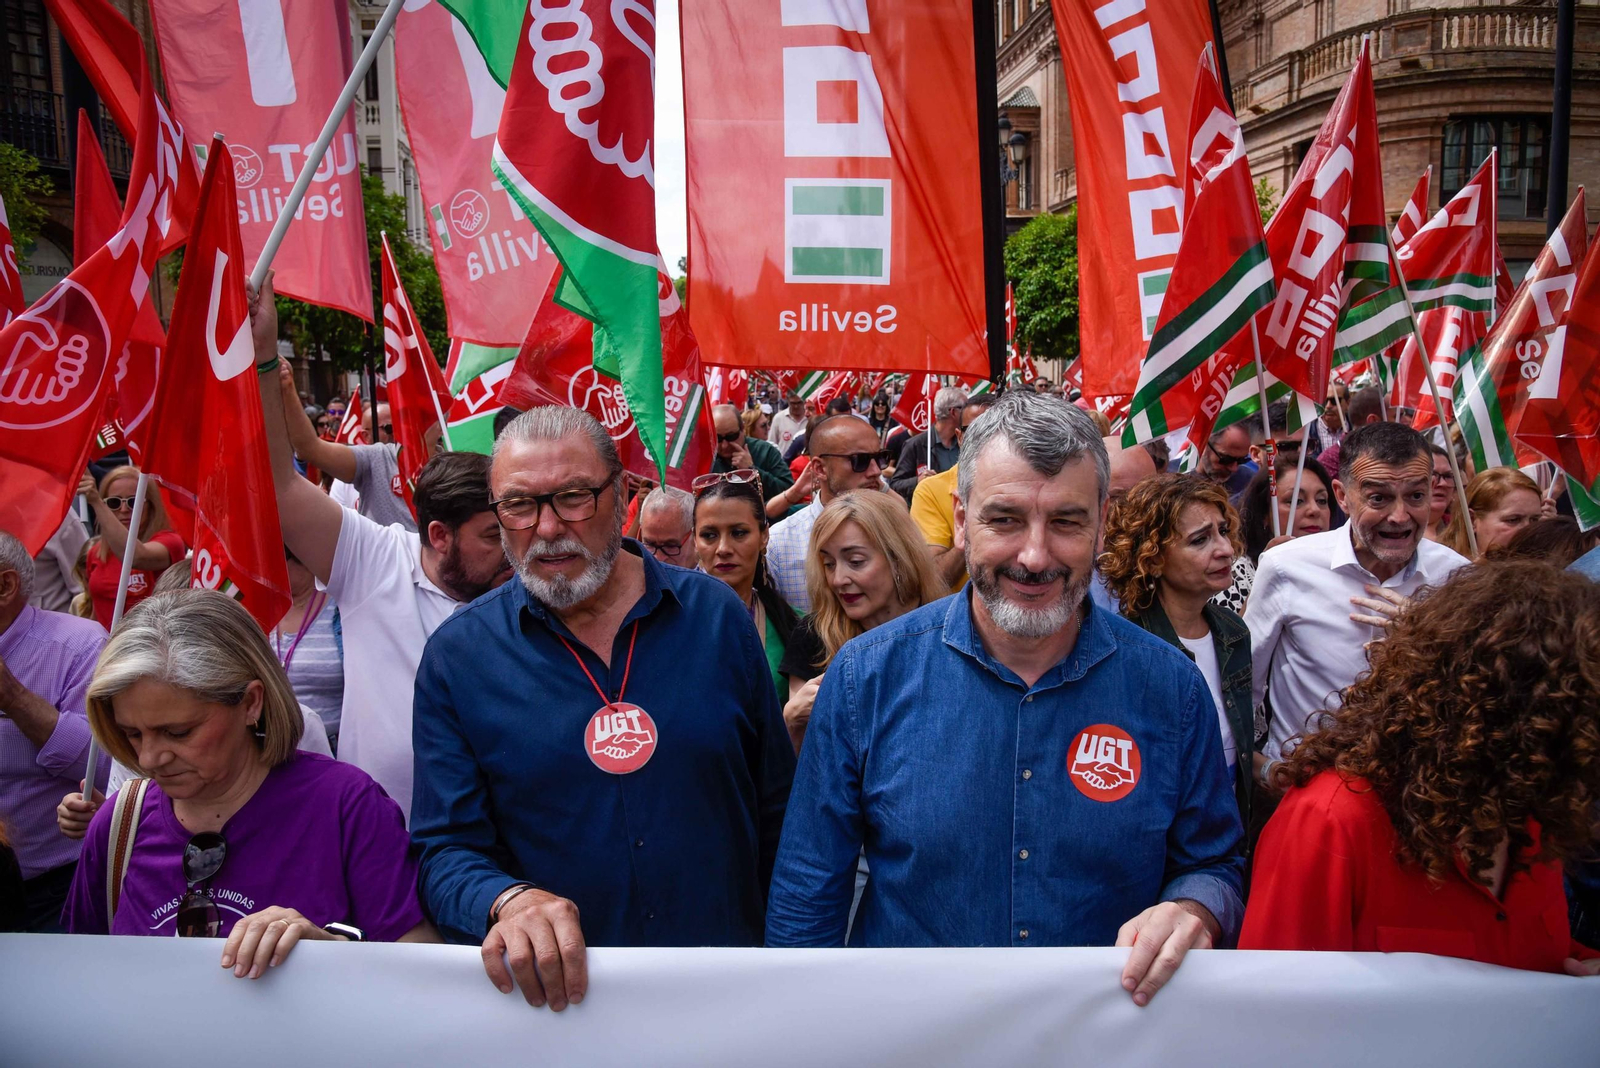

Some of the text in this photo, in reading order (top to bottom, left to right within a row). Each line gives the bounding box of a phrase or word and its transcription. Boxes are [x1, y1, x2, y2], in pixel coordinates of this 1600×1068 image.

[595, 709, 641, 741] UGT
[1076, 733, 1133, 771] UGT
[217, 888, 255, 910] UNIDAS
